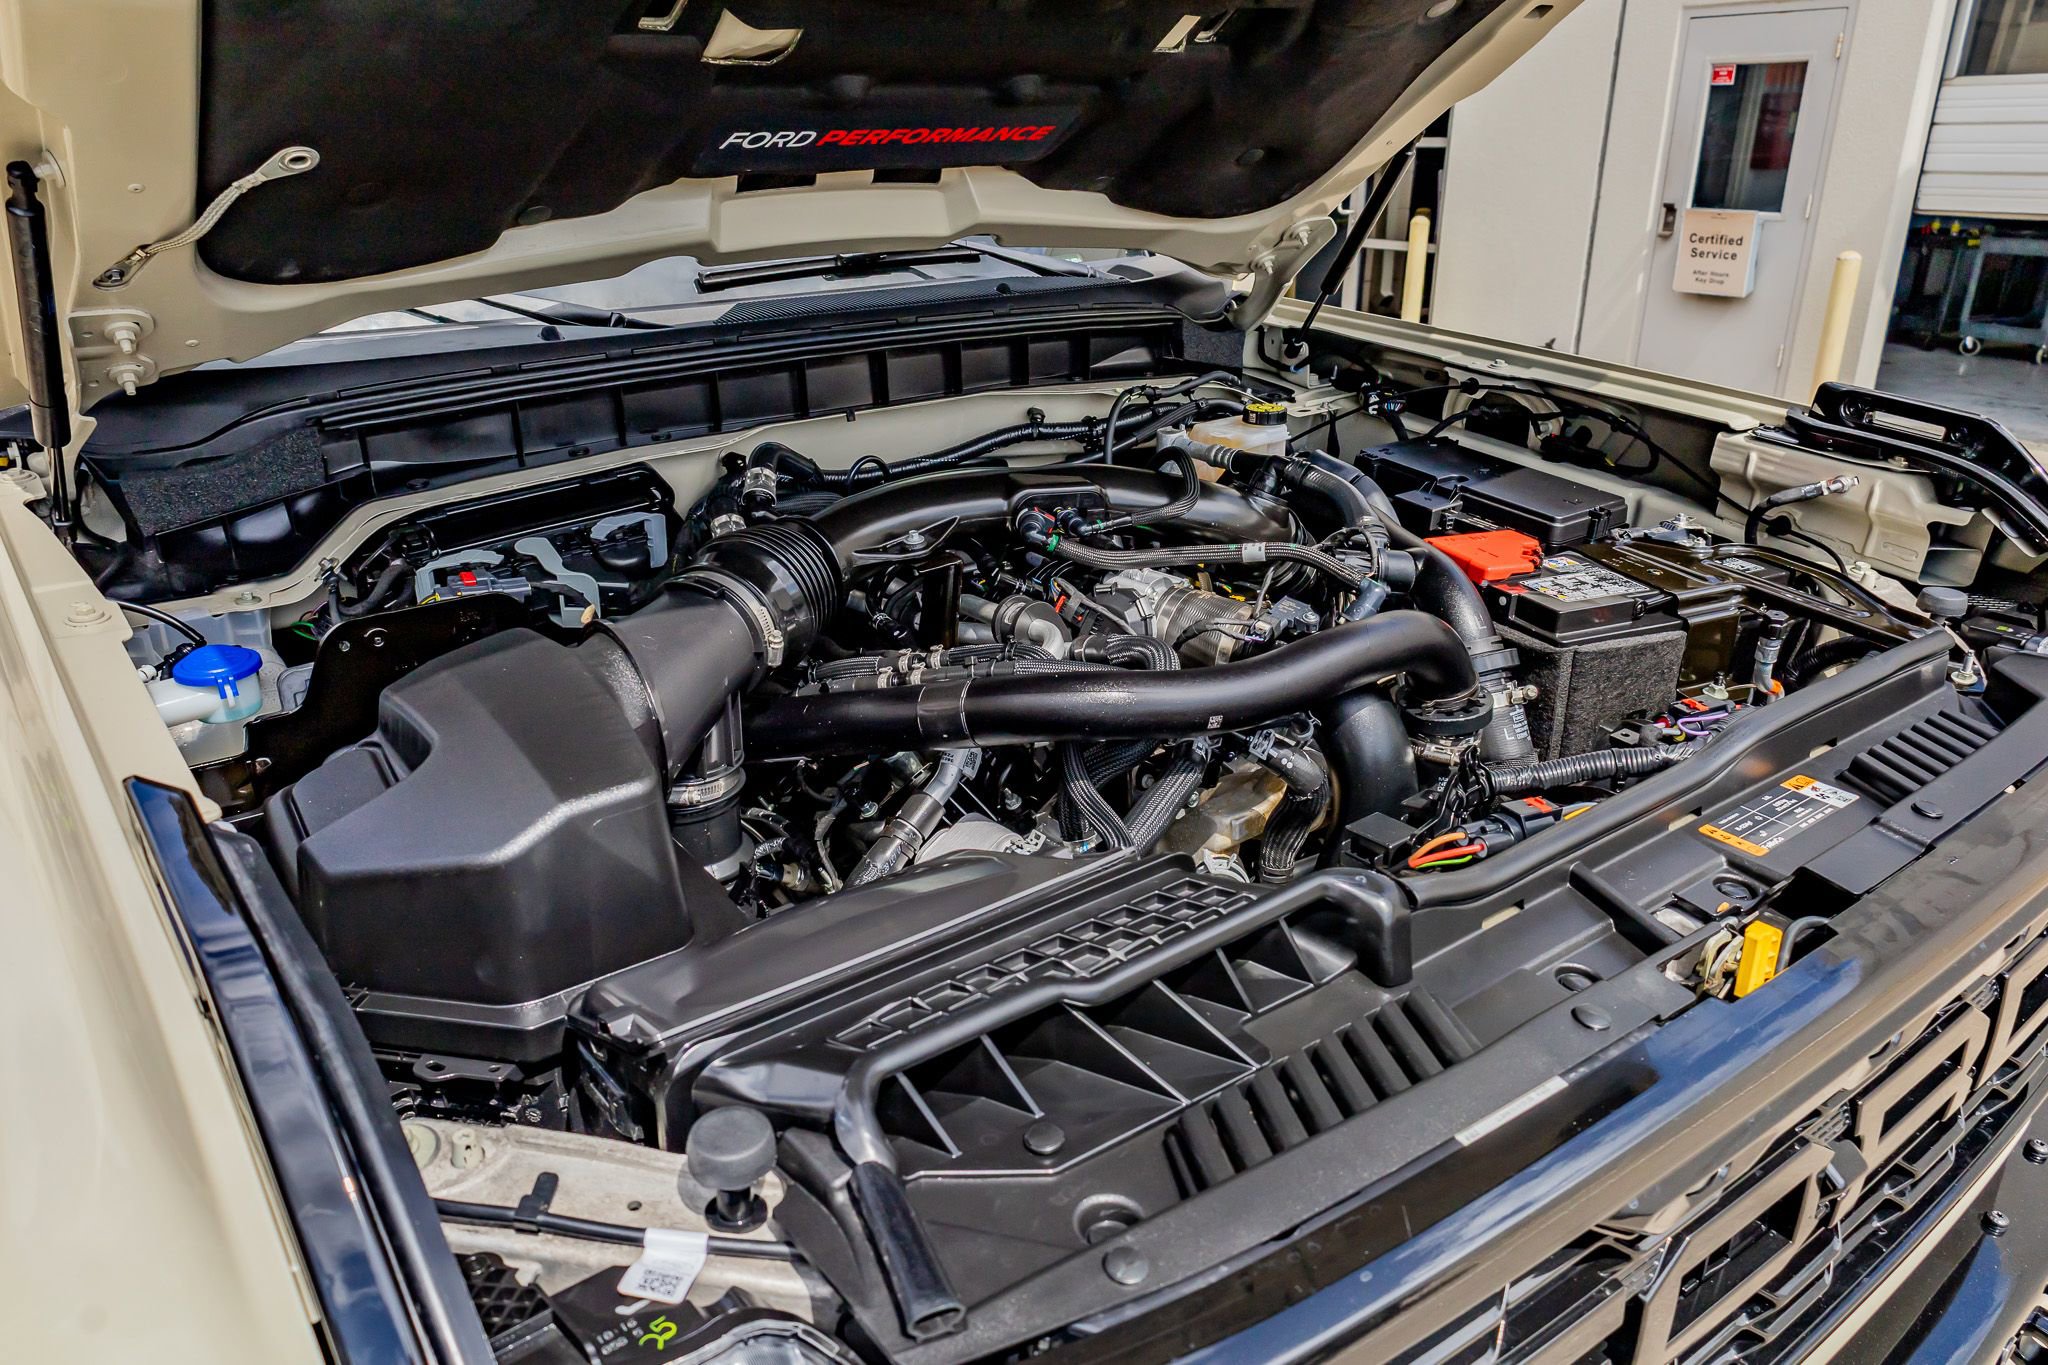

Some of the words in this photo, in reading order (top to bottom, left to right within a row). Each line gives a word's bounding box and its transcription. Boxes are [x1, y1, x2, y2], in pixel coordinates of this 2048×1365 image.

[718, 130, 818, 150] FORD
[816, 124, 1057, 147] PERFORMANCE
[1689, 232, 1744, 246] Certified
[1690, 247, 1738, 261] Service
